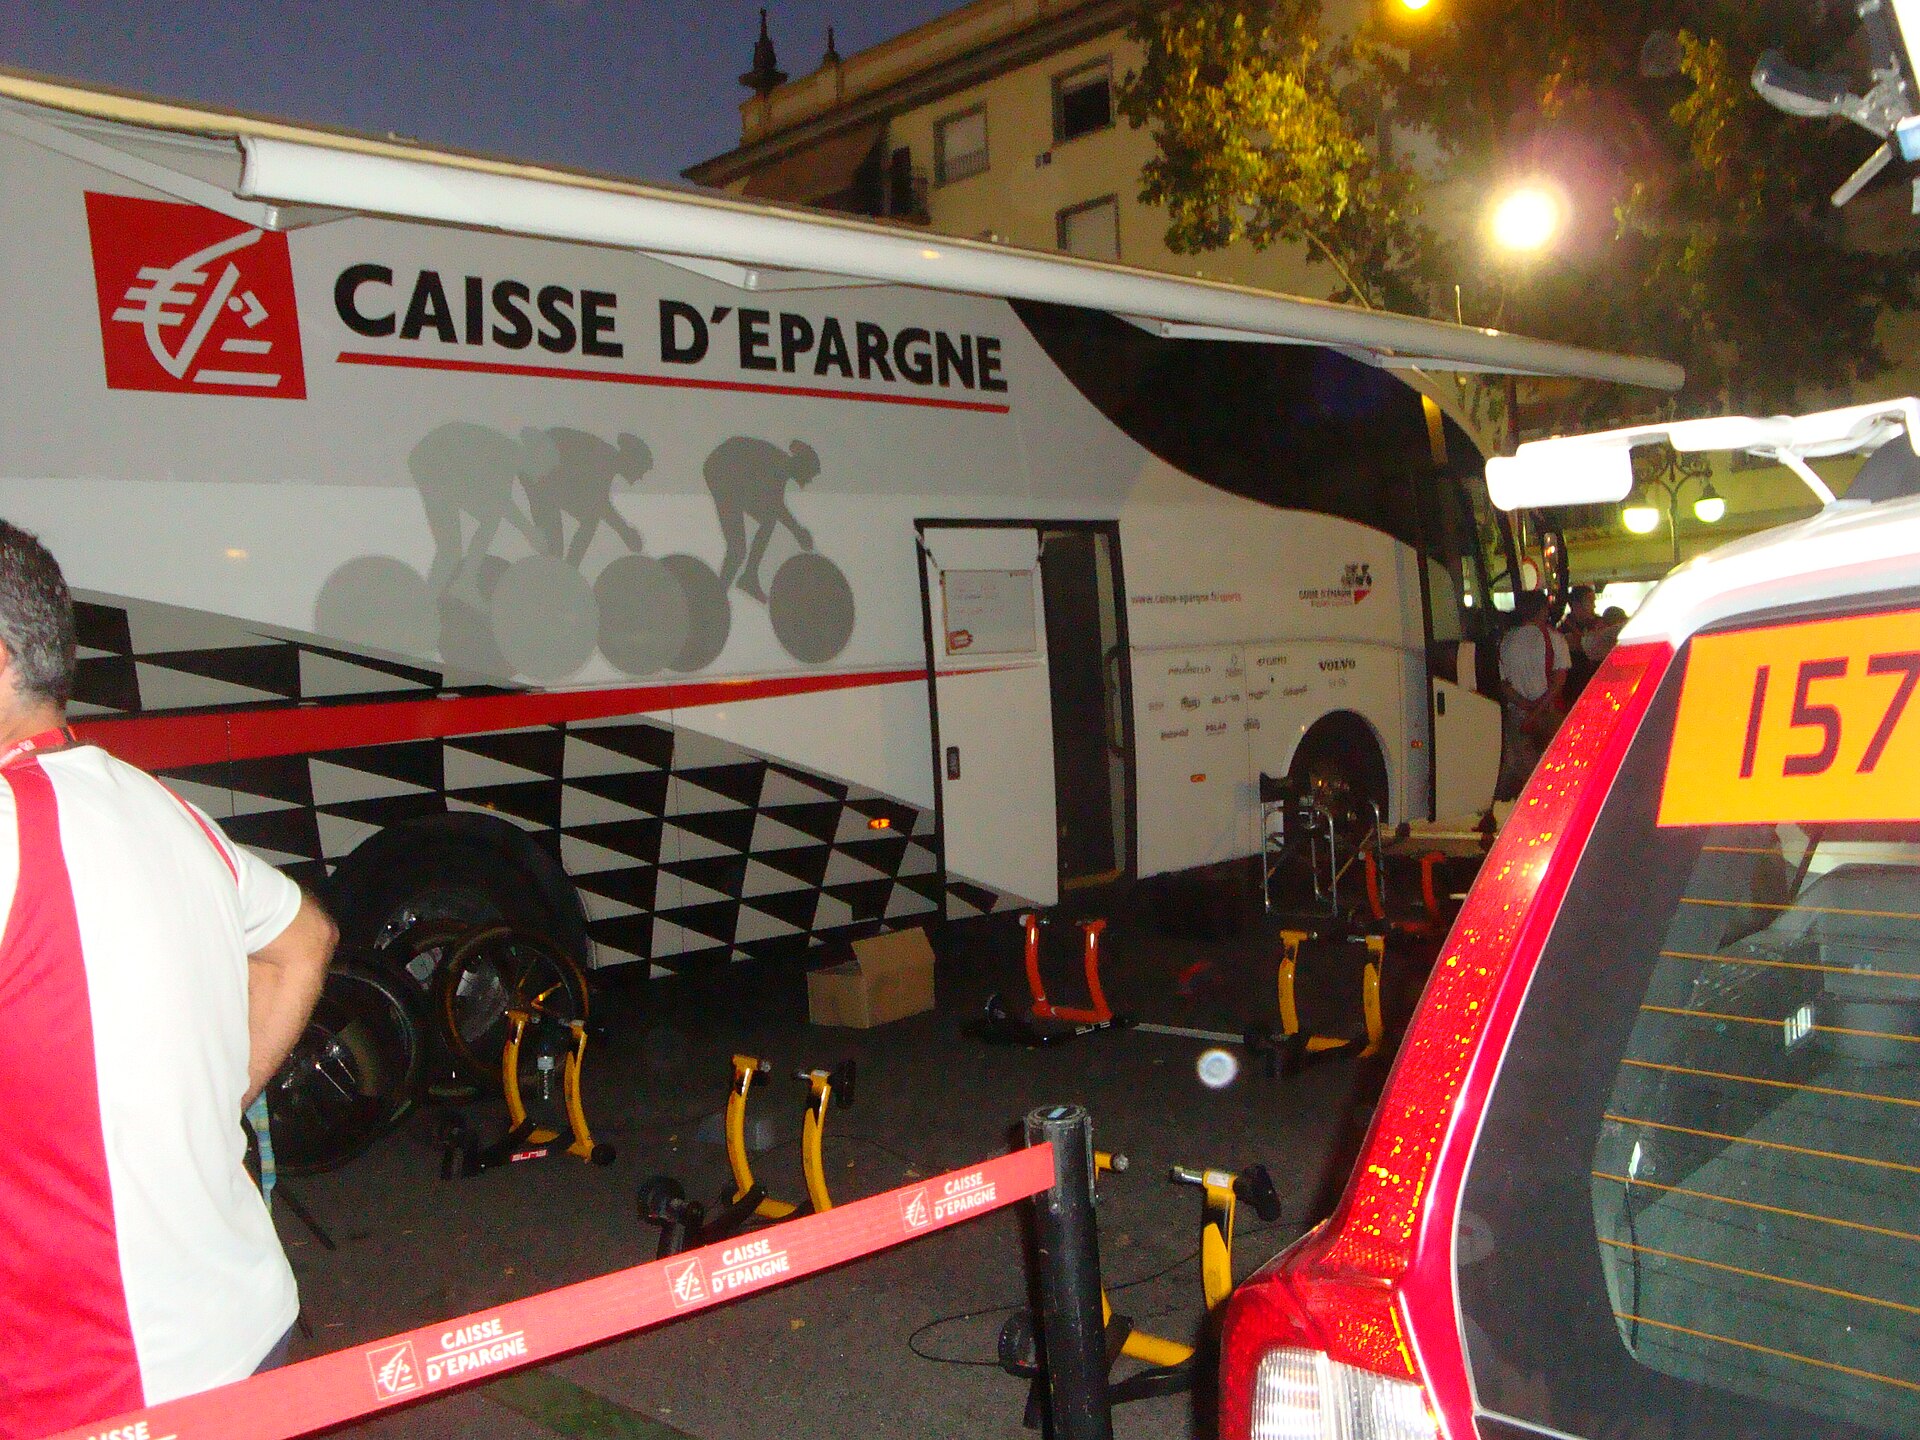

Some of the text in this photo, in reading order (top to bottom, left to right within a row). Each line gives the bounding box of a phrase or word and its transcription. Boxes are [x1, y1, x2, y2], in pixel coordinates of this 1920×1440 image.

[334, 263, 1008, 393] CAISSE D'EPARGNE
[1318, 657, 1356, 672] VOLVO
[1738, 650, 1920, 780] 157
[944, 1171, 984, 1195] CAISSE
[935, 1187, 997, 1220] D'EPARGNE
[722, 1239, 771, 1266] CAISSE
[711, 1254, 790, 1294] D'EPARGNE
[441, 1318, 503, 1349] CAISSE
[427, 1336, 528, 1382] D'EPARGNE
